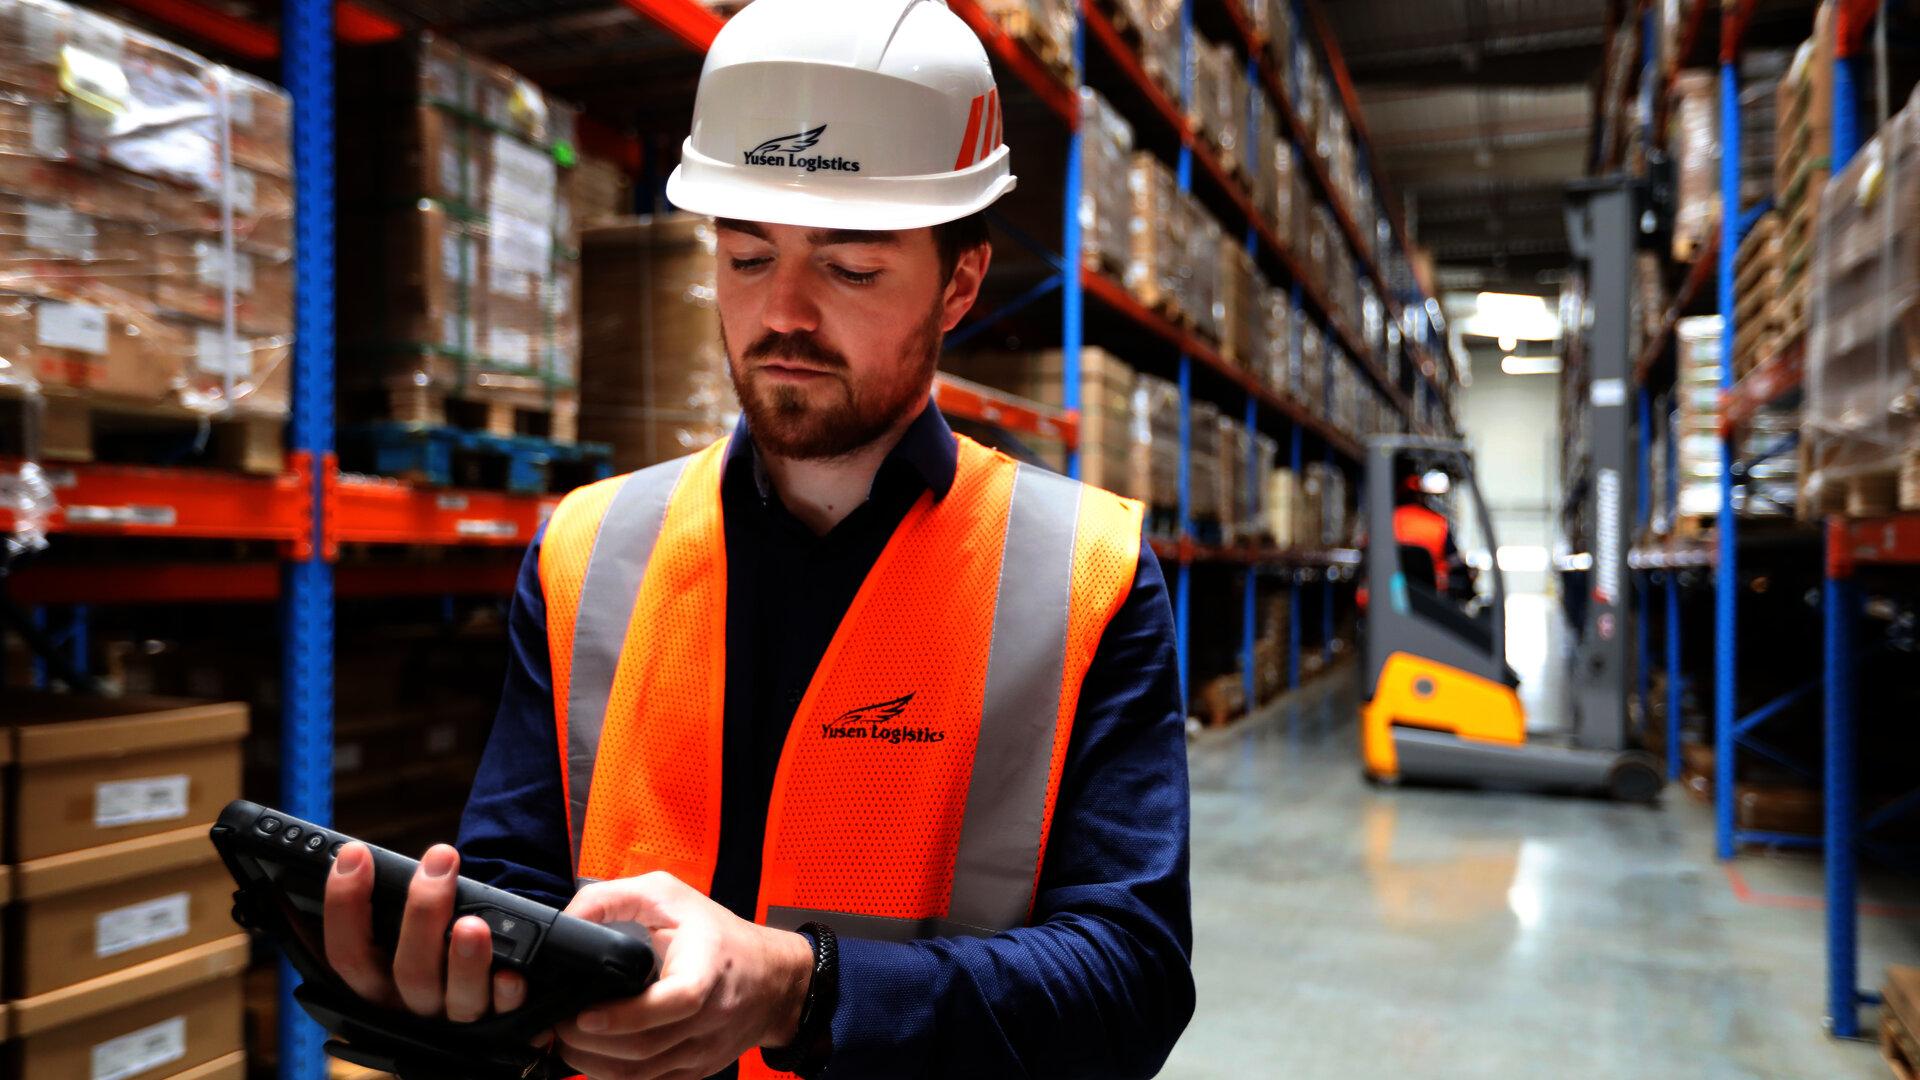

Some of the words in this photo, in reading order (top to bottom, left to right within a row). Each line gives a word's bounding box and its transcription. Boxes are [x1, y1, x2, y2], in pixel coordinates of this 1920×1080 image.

[744, 151, 785, 167] Yusen
[788, 153, 860, 172] Logistics
[822, 724, 867, 739] Yusen
[871, 724, 944, 744] Logistics
